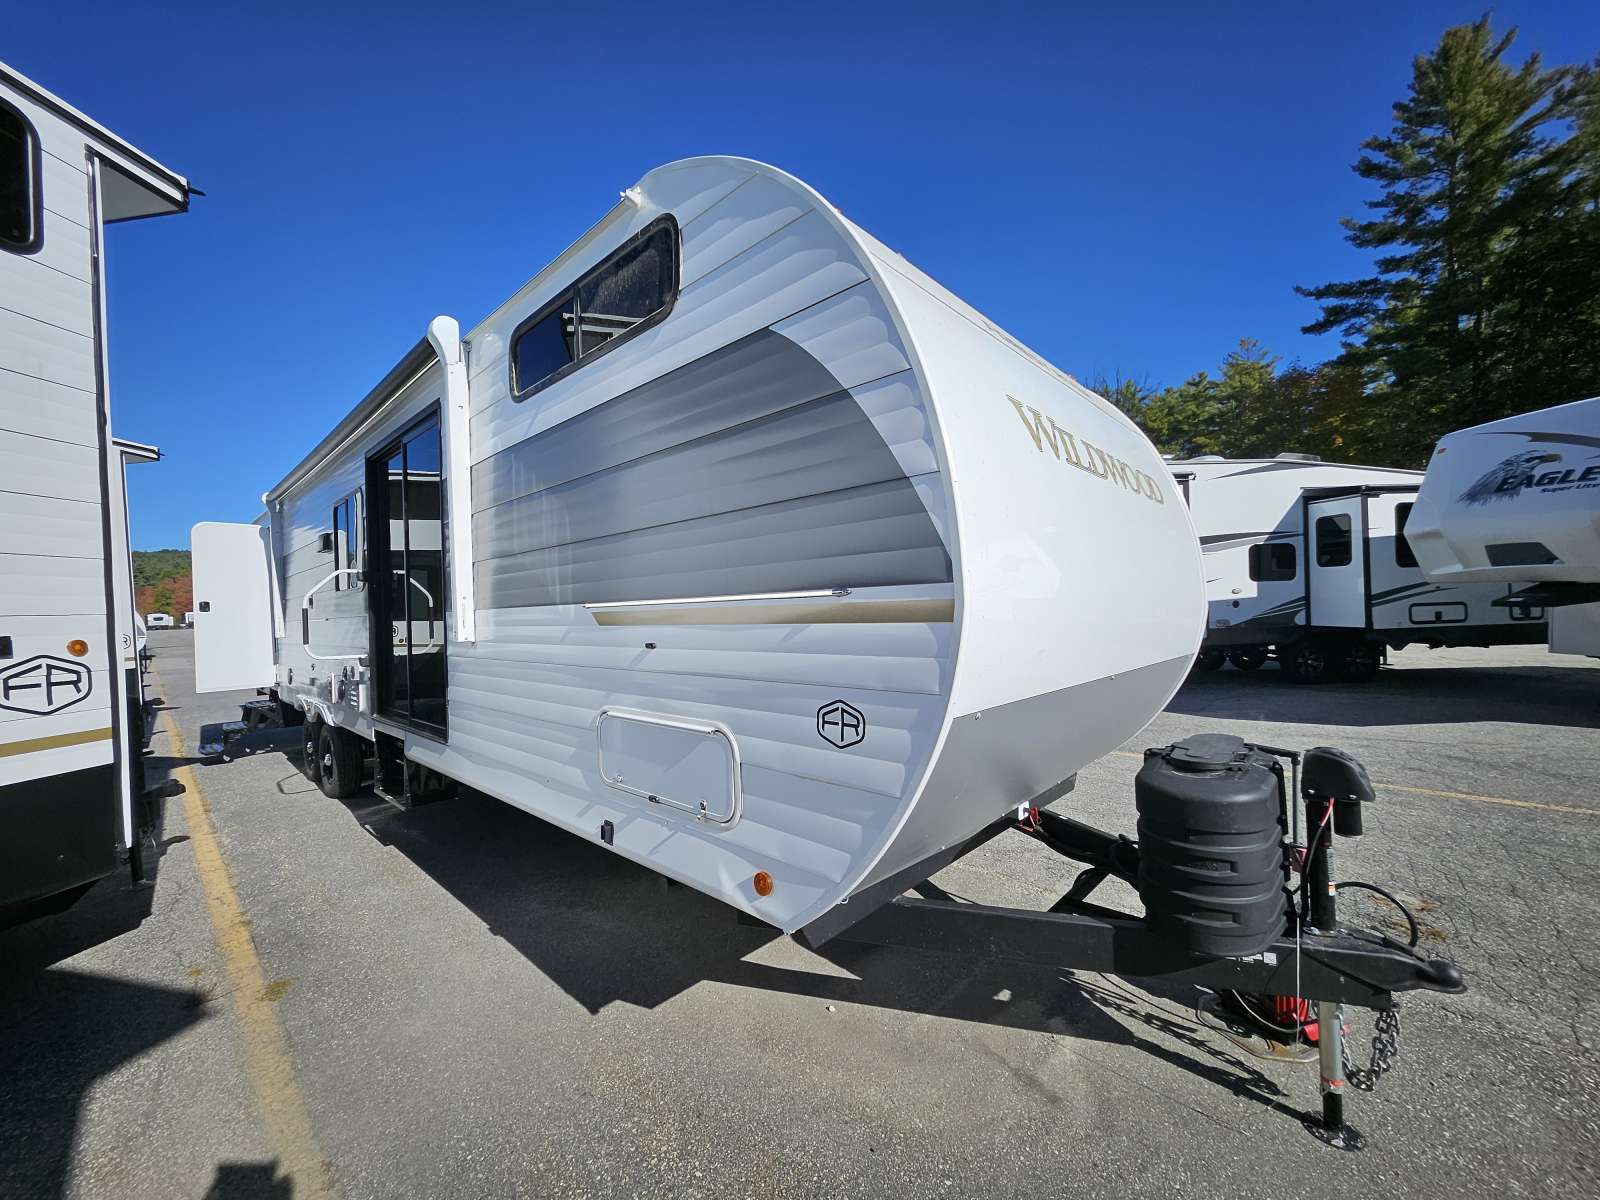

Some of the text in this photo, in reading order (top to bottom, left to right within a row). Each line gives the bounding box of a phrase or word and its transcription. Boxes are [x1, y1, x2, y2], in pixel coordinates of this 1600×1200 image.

[1006, 394, 1165, 505] WILDWOOD
[1494, 466, 1600, 493] EAGLE
[822, 706, 860, 742] FR
